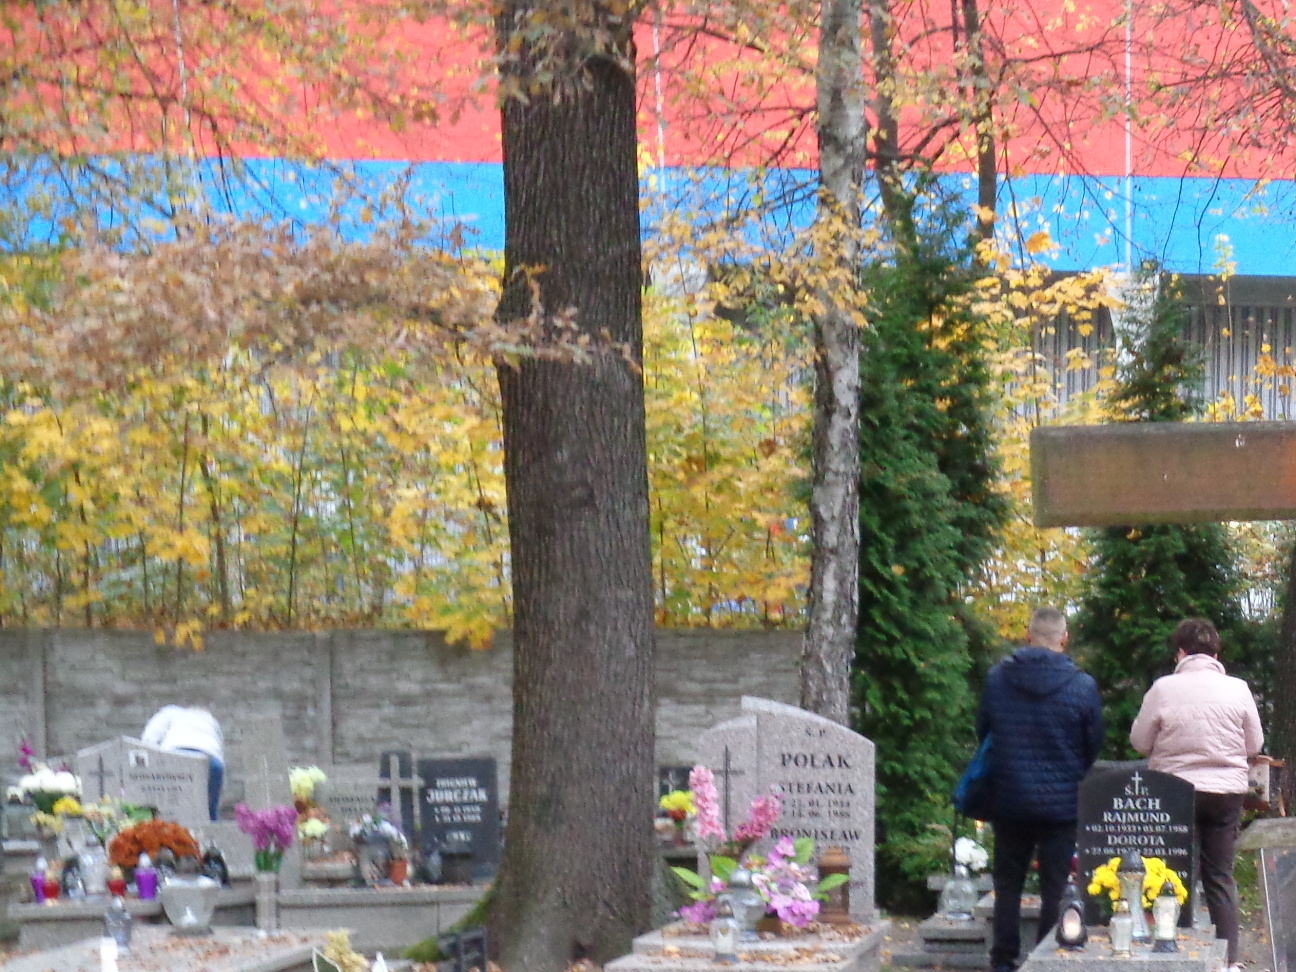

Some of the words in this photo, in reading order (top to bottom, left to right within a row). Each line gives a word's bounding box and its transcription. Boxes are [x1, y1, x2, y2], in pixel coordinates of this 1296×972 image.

[781, 752, 852, 769] POLAK
[426, 788, 488, 803] JURCZAK
[779, 782, 854, 796] STEFANIA
[1112, 797, 1161, 810] BACH
[1103, 811, 1171, 823] RAJMUND
[1107, 834, 1165, 846] DOROTA
